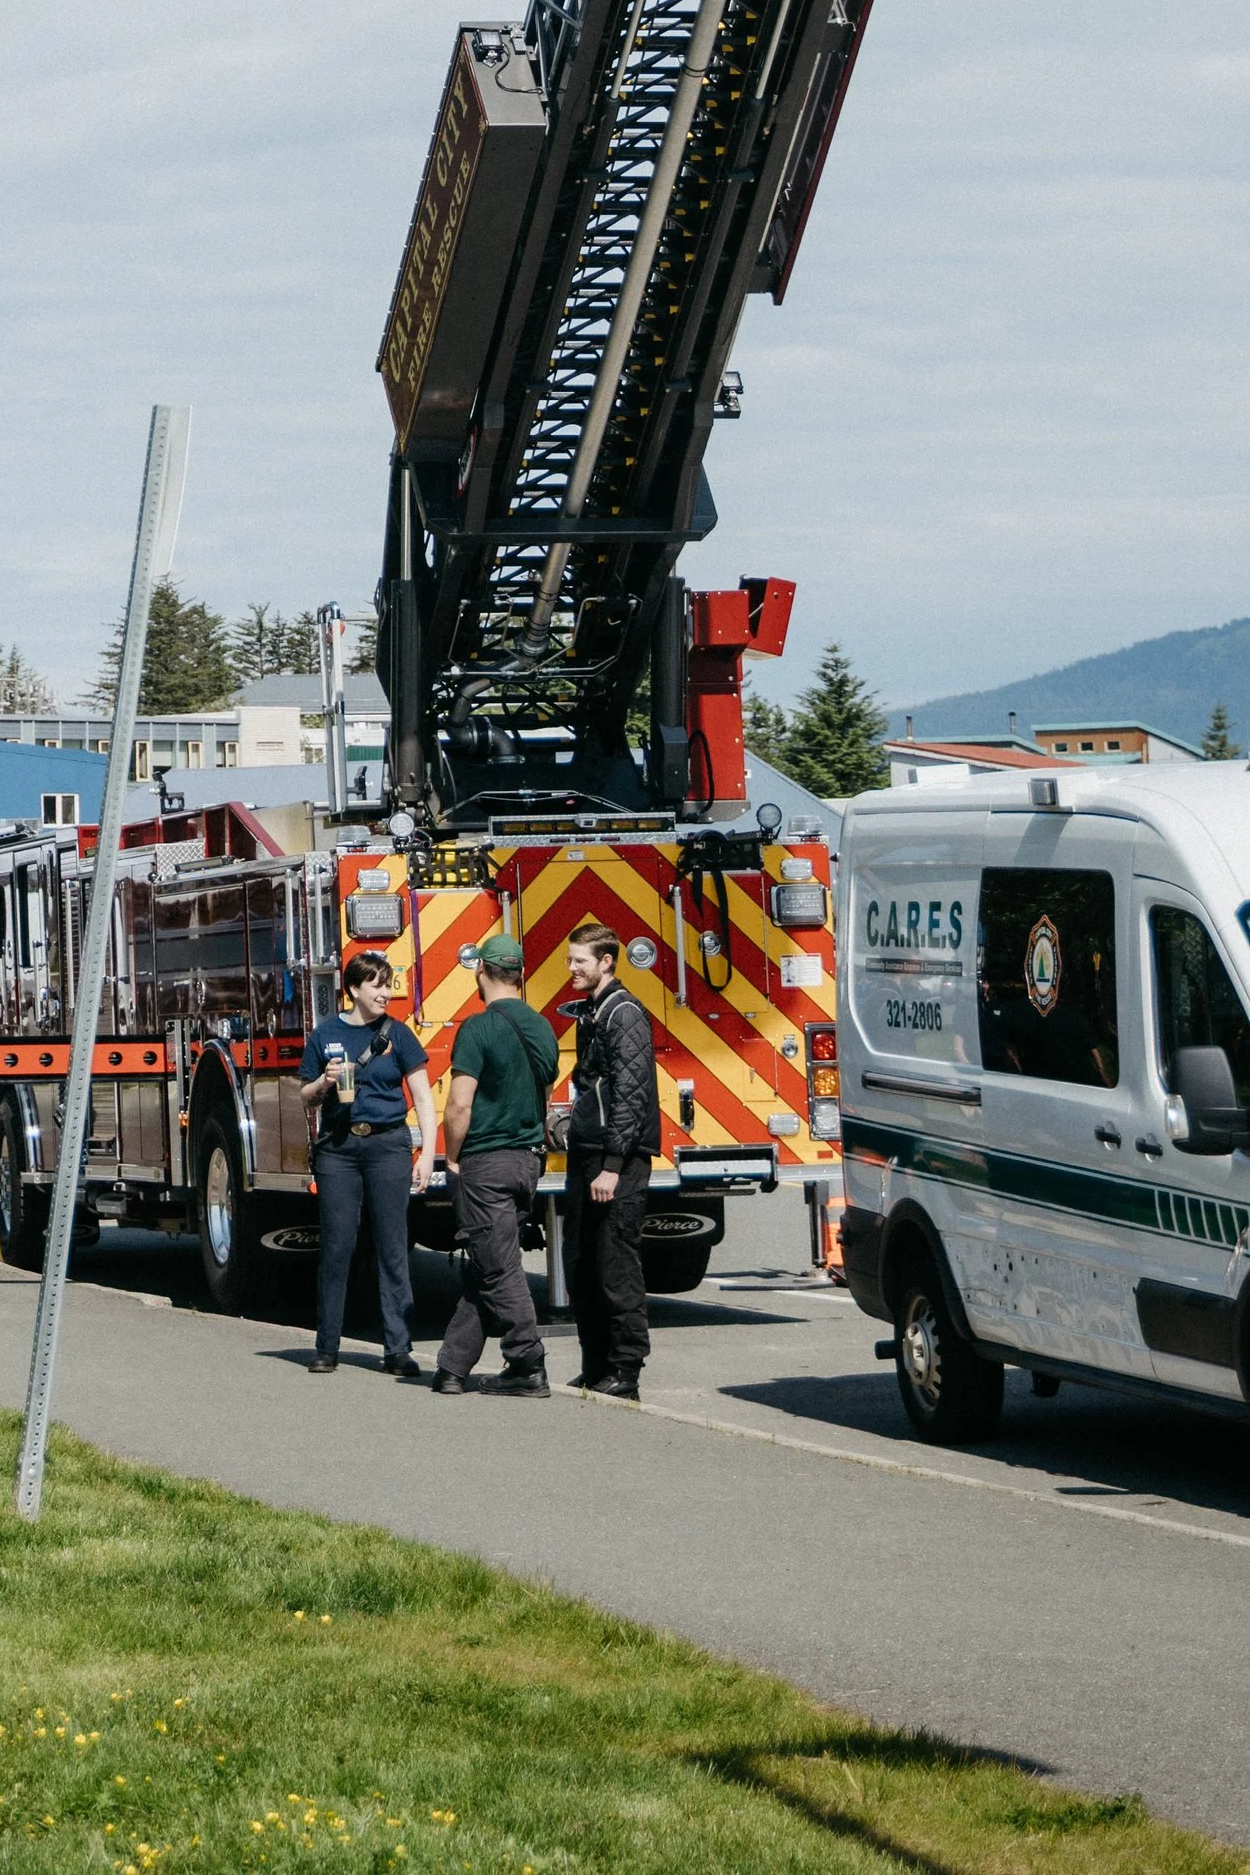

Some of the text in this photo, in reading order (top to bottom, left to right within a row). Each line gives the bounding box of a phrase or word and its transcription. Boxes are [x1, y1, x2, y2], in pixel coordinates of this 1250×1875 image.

[390, 70, 468, 383] CAPITAL CITY
[408, 151, 470, 392] FIRE RESCUE
[866, 900, 963, 950] C.A.R.E.S
[886, 999, 943, 1032] 321-2806
[639, 1218, 699, 1235] Pierce
